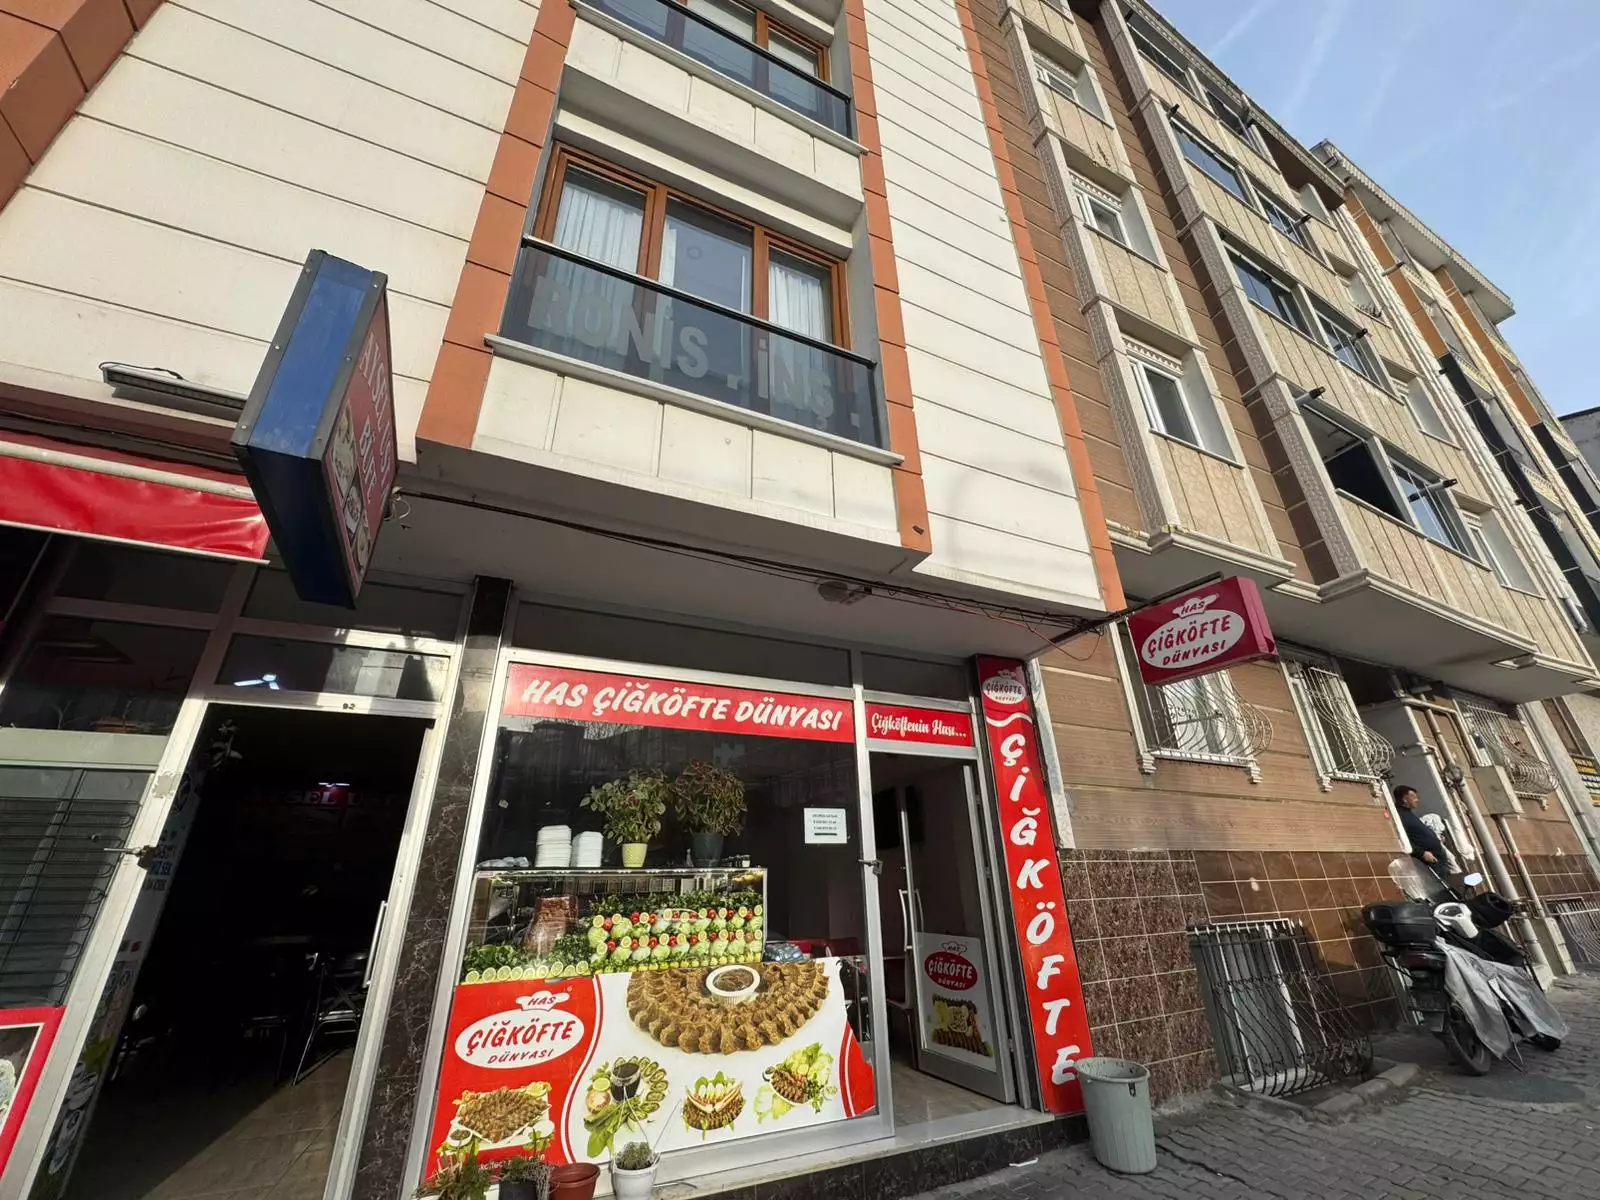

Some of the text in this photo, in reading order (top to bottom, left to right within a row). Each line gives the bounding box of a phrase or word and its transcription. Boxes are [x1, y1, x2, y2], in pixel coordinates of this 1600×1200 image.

[359, 413, 378, 505] BÜFE
[1181, 600, 1205, 614] HAS
[1147, 615, 1231, 659] ÇİĞKÖFTE
[1162, 640, 1226, 666] DÜNYASI
[986, 680, 1023, 695] ÇİĞKÖFTE
[521, 679, 843, 731] HAS ÇİĞKÖFTE DÜNYASI
[871, 712, 930, 737] Çiğköftenin
[999, 732, 1080, 1086] ÇİĞKÖFTE
[928, 956, 973, 981] ÇİĞKÖFTE
[527, 996, 556, 1006] HAS
[466, 1018, 576, 1057] ÇİĞKÖFTE
[487, 1049, 554, 1064] DÜNYASI
